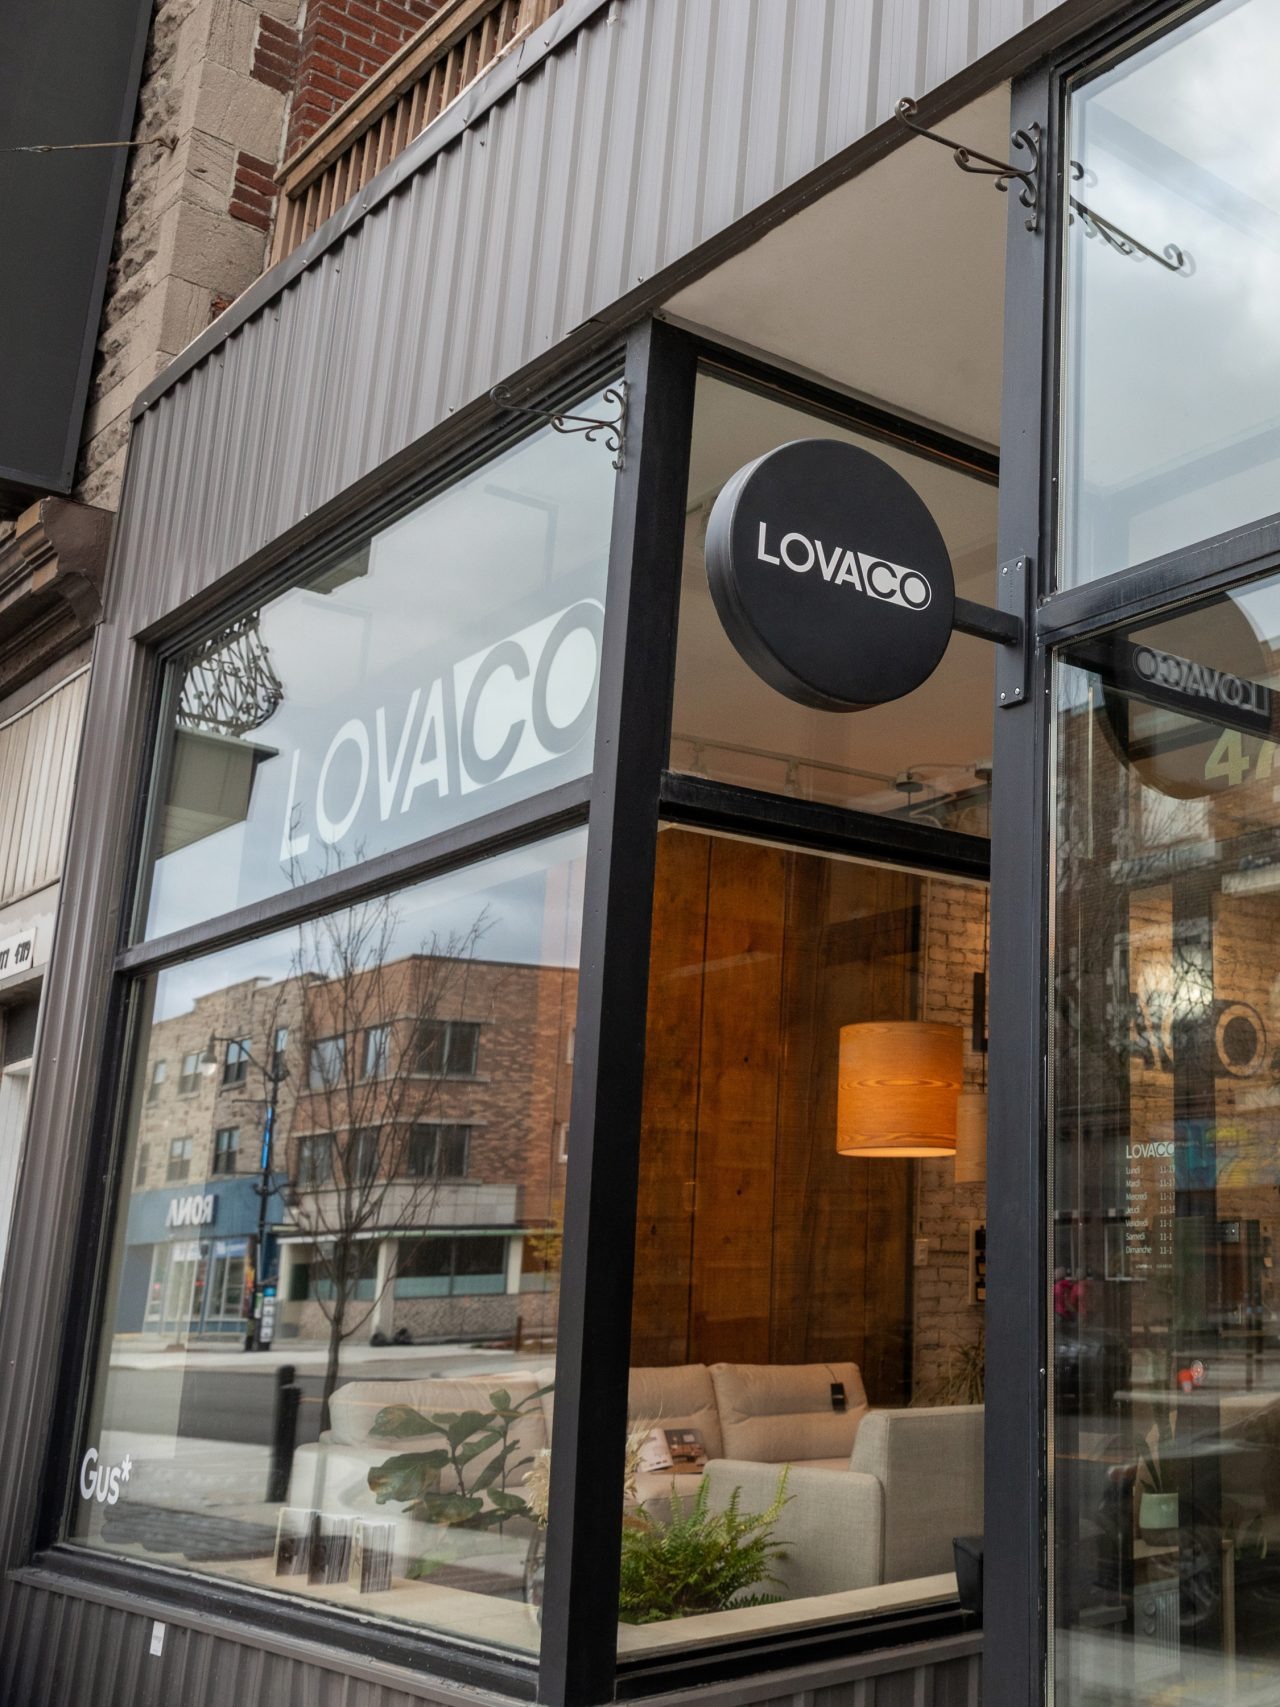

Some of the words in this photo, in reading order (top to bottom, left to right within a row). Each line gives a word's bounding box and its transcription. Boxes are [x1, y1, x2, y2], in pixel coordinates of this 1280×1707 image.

[758, 521, 932, 611] LOVACO
[279, 598, 605, 862] LOVACO
[1125, 1232, 1146, 1241] Samedi
[1125, 1245, 1152, 1254] Dimanche
